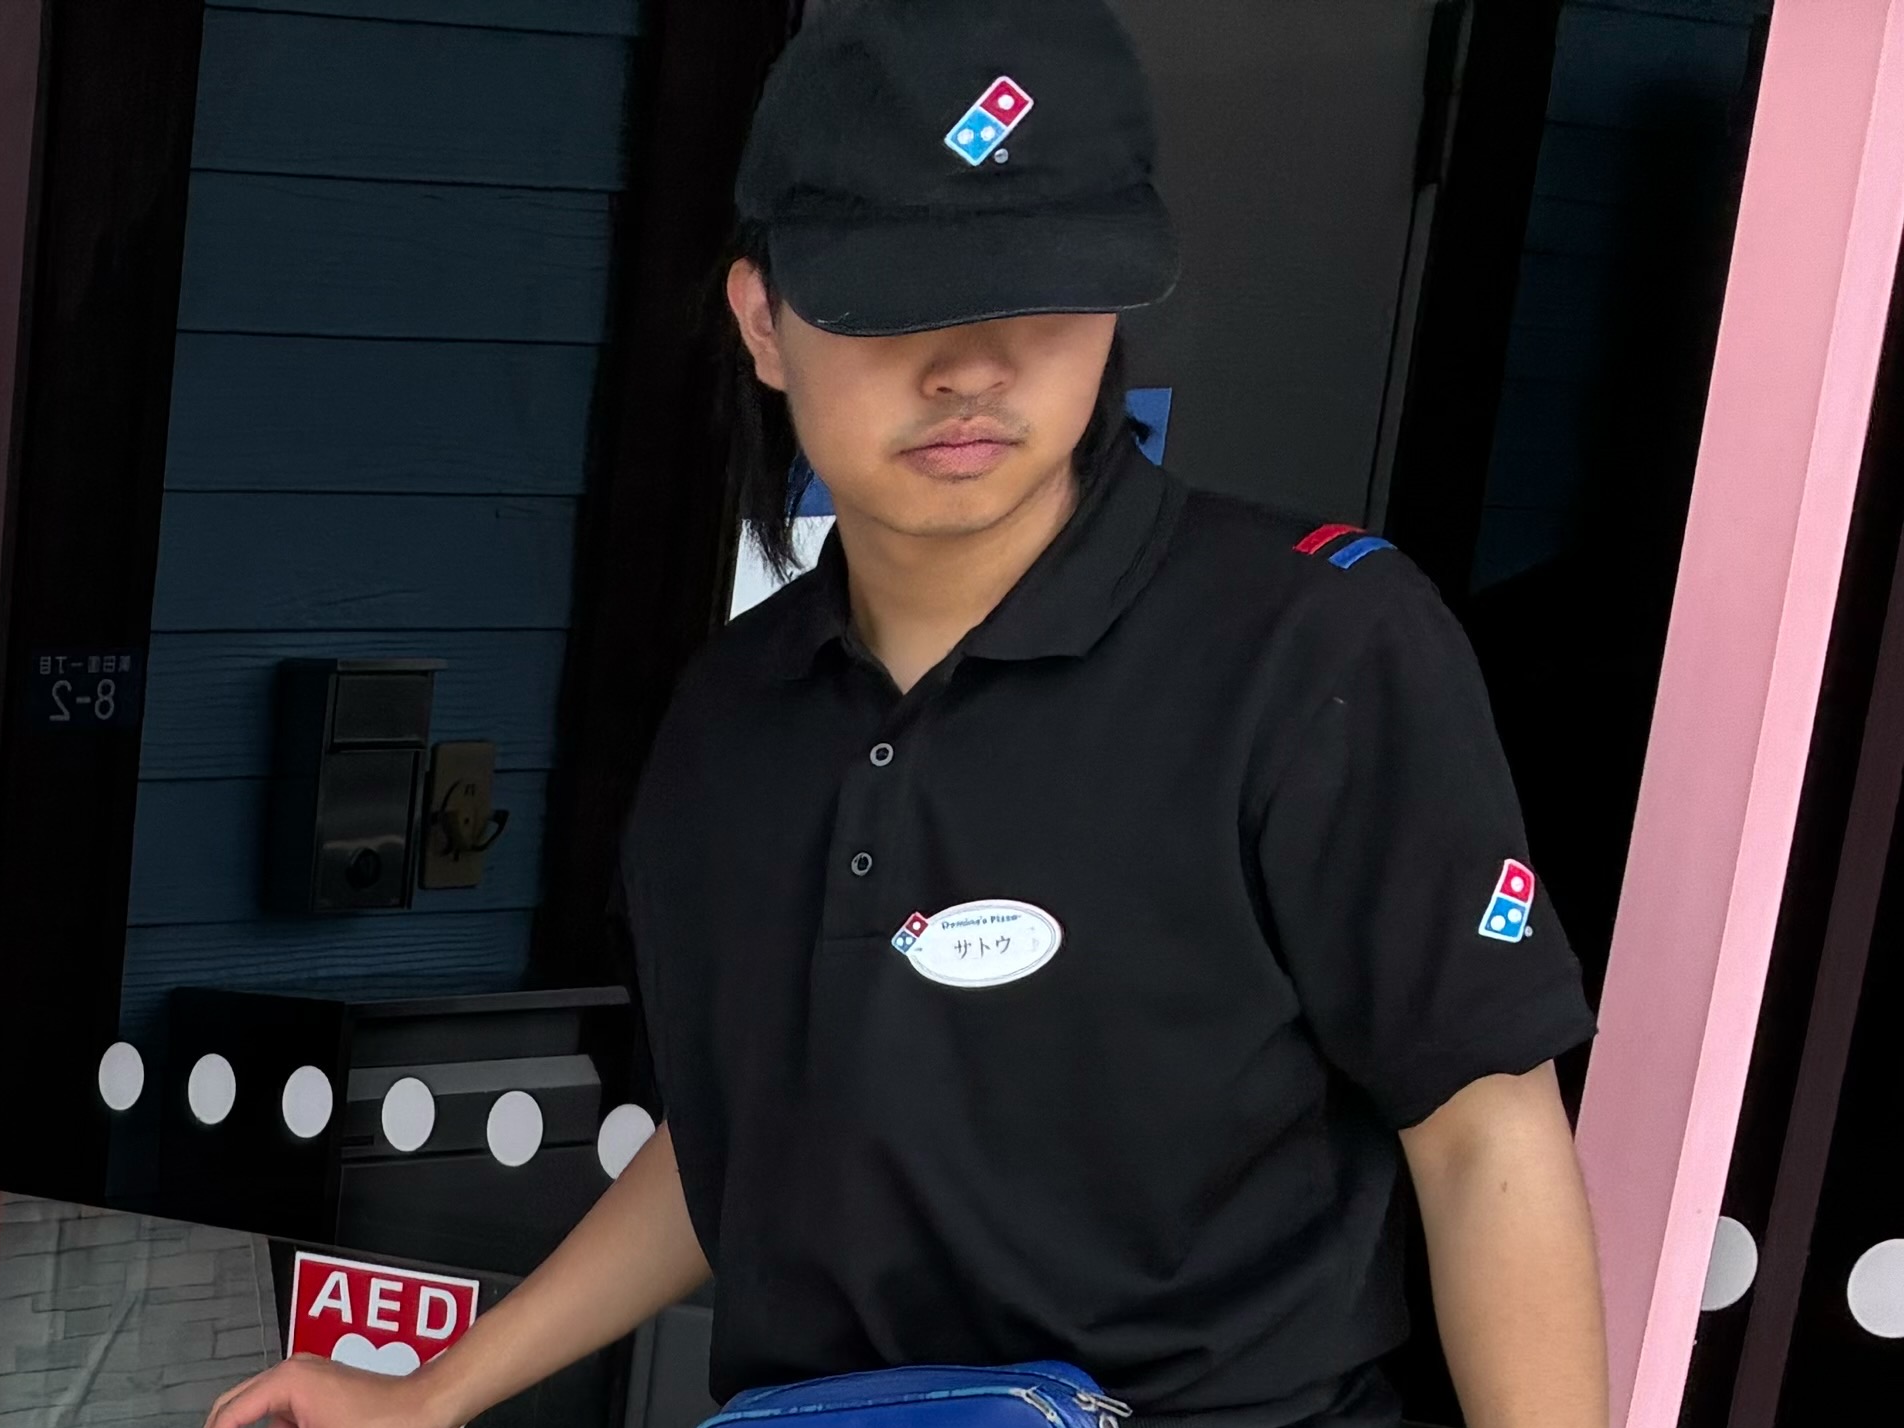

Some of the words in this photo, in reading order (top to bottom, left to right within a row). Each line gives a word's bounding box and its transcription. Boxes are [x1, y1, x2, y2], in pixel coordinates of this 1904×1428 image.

[953, 935, 1011, 960] サトウ
[308, 1271, 458, 1340] AED
